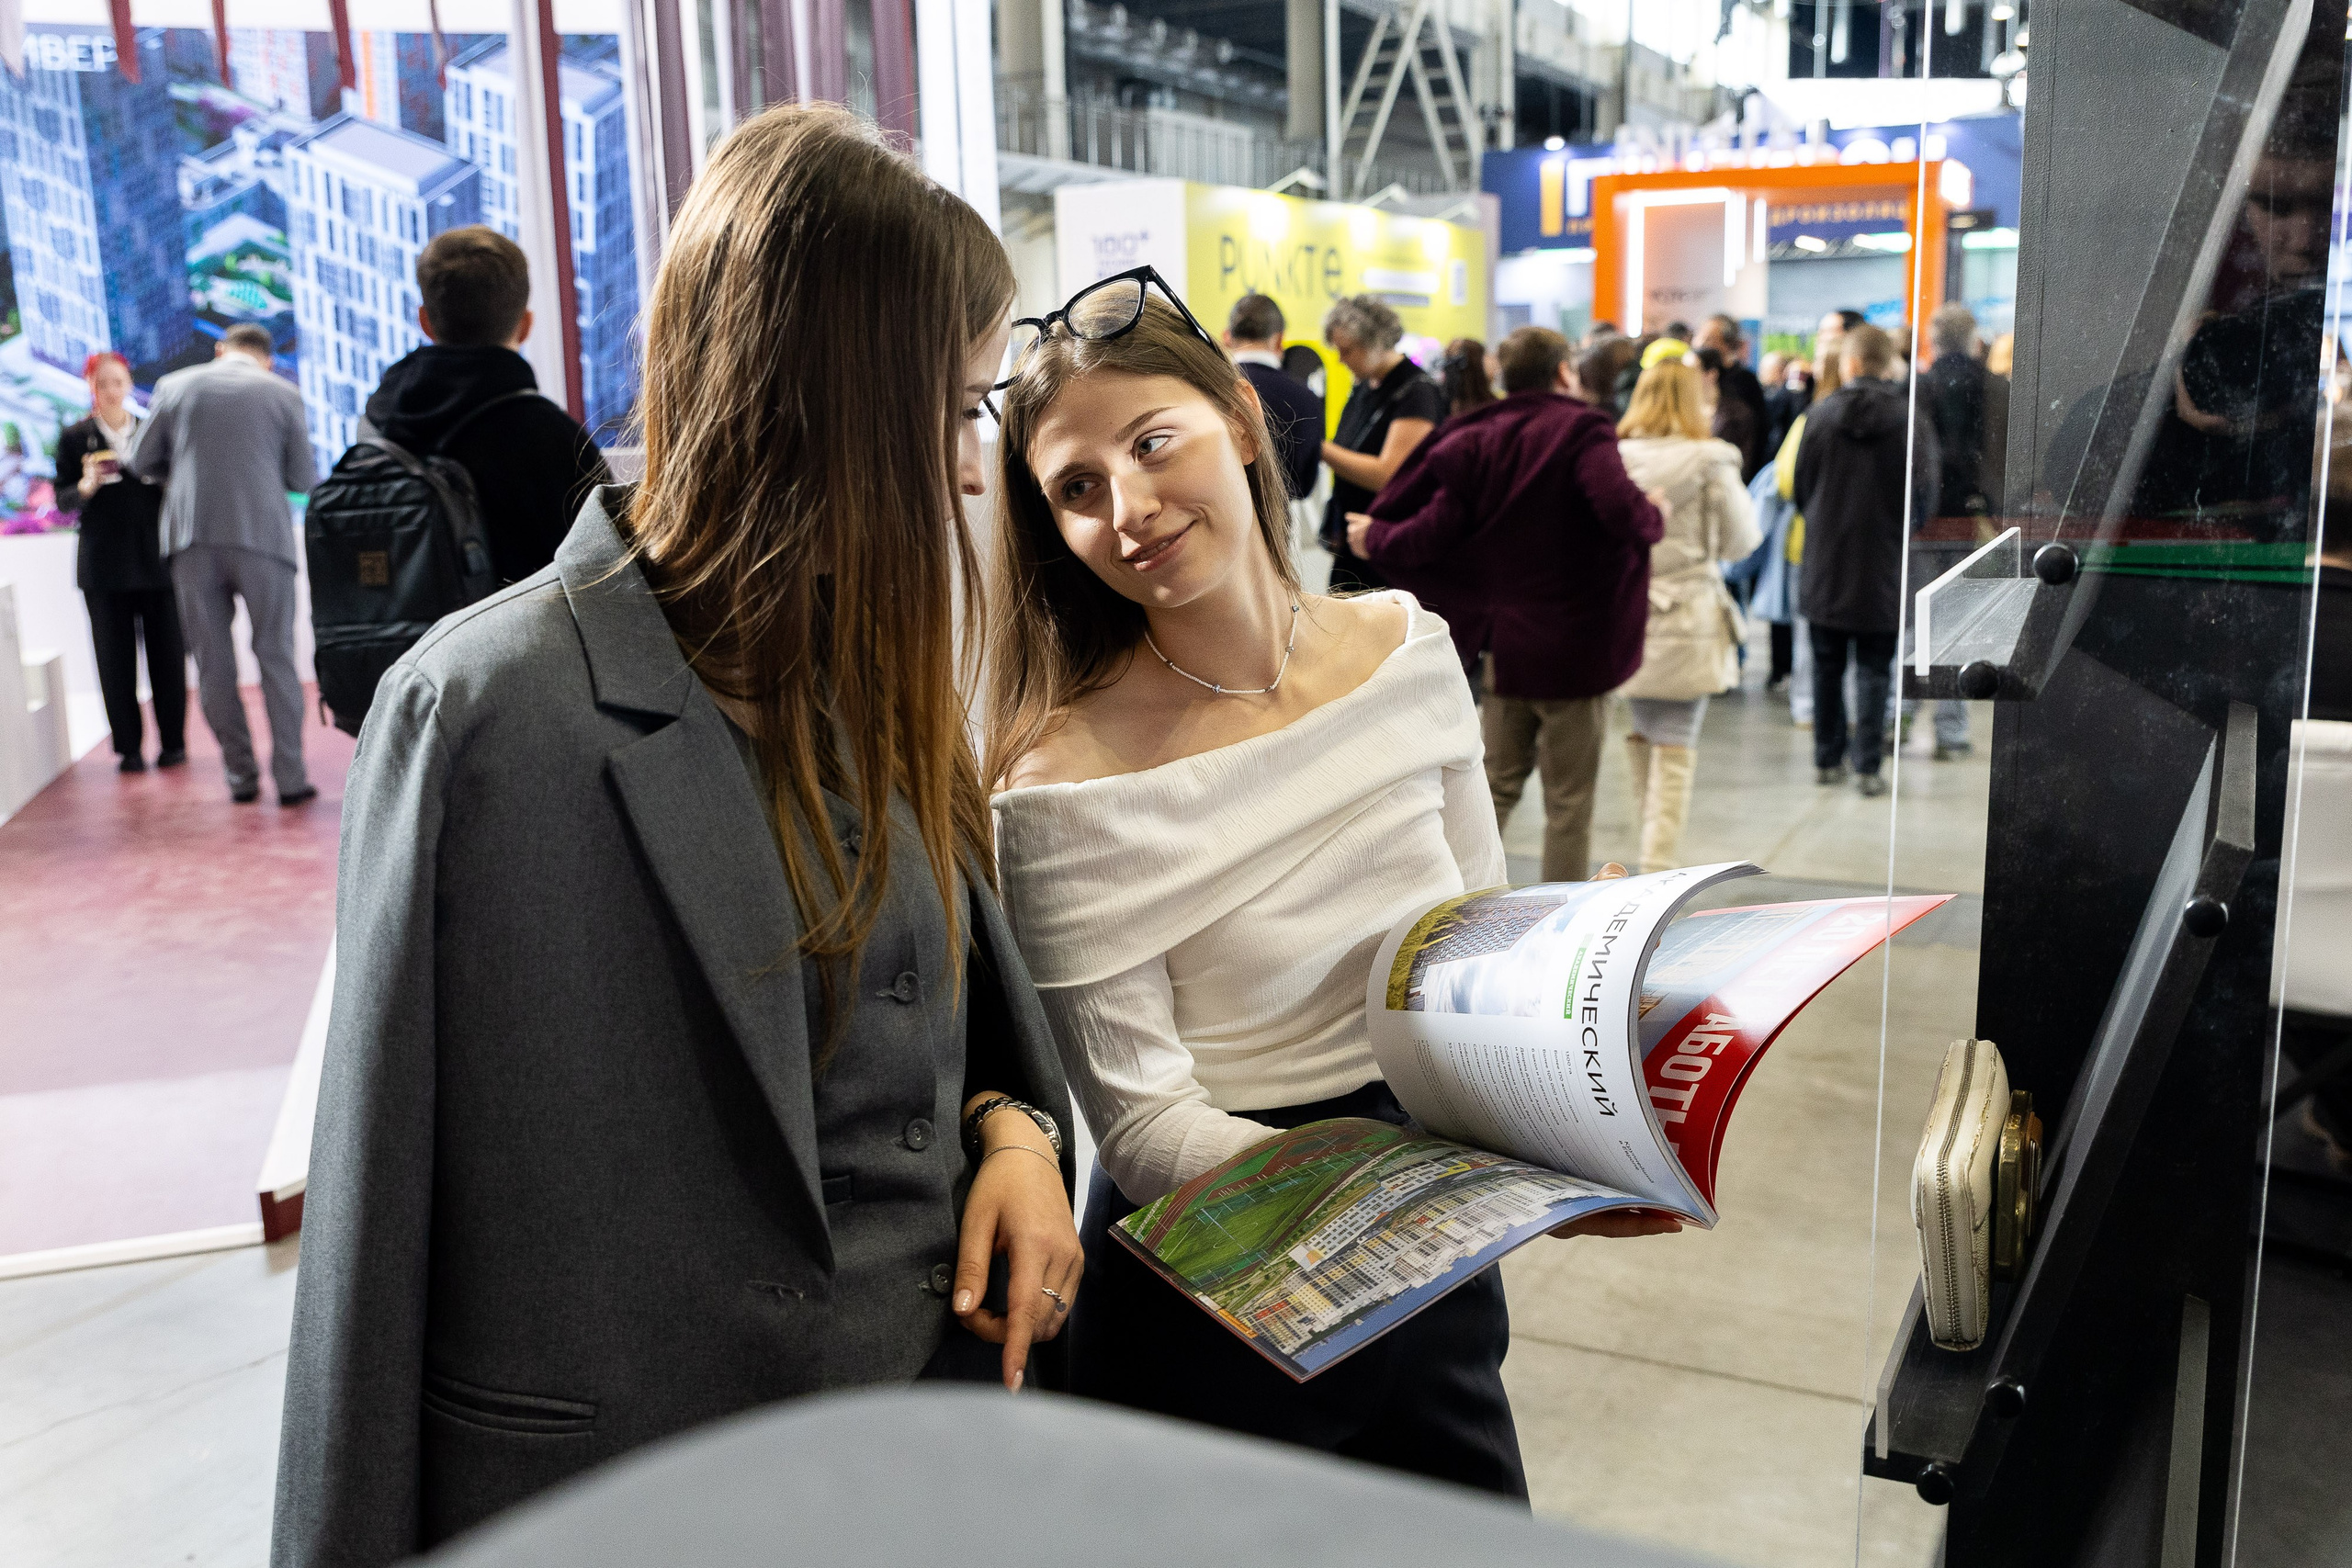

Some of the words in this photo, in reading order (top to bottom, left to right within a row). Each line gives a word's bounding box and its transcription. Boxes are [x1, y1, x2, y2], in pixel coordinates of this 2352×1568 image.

[1580, 872, 1688, 1117] АКАДЕМИЧЕСКИЙ
[1450, 1050, 1454, 1058] км
[1457, 1042, 1471, 1079] инженерной
[1463, 1043, 1476, 1082] Собственные
[1473, 1043, 1486, 1082] Собственная
[1483, 1043, 1497, 1085] Собственный
[1494, 1085, 1502, 1099] парк
[1504, 1045, 1517, 1086] Собственная
[1514, 1086, 1526, 1110] система
[1516, 1053, 1533, 1103] художественные
[1532, 1103, 1544, 1122] школы
[1520, 1046, 1528, 1072] Дворец
[1525, 1072, 1534, 1093] дзюдо
[1534, 1099, 1551, 1127] Академия
[1650, 1003, 1750, 1156] АБОТ
[1539, 1084, 1551, 1108] детских
[1549, 1109, 1560, 1126] садов
[1555, 1097, 1568, 1122] жителей
[1561, 1083, 1570, 1103] жилых
[1567, 1104, 1579, 1123] домов
[1622, 1145, 1640, 1171] Европе
[1624, 1141, 1655, 1184] Крупнейший
